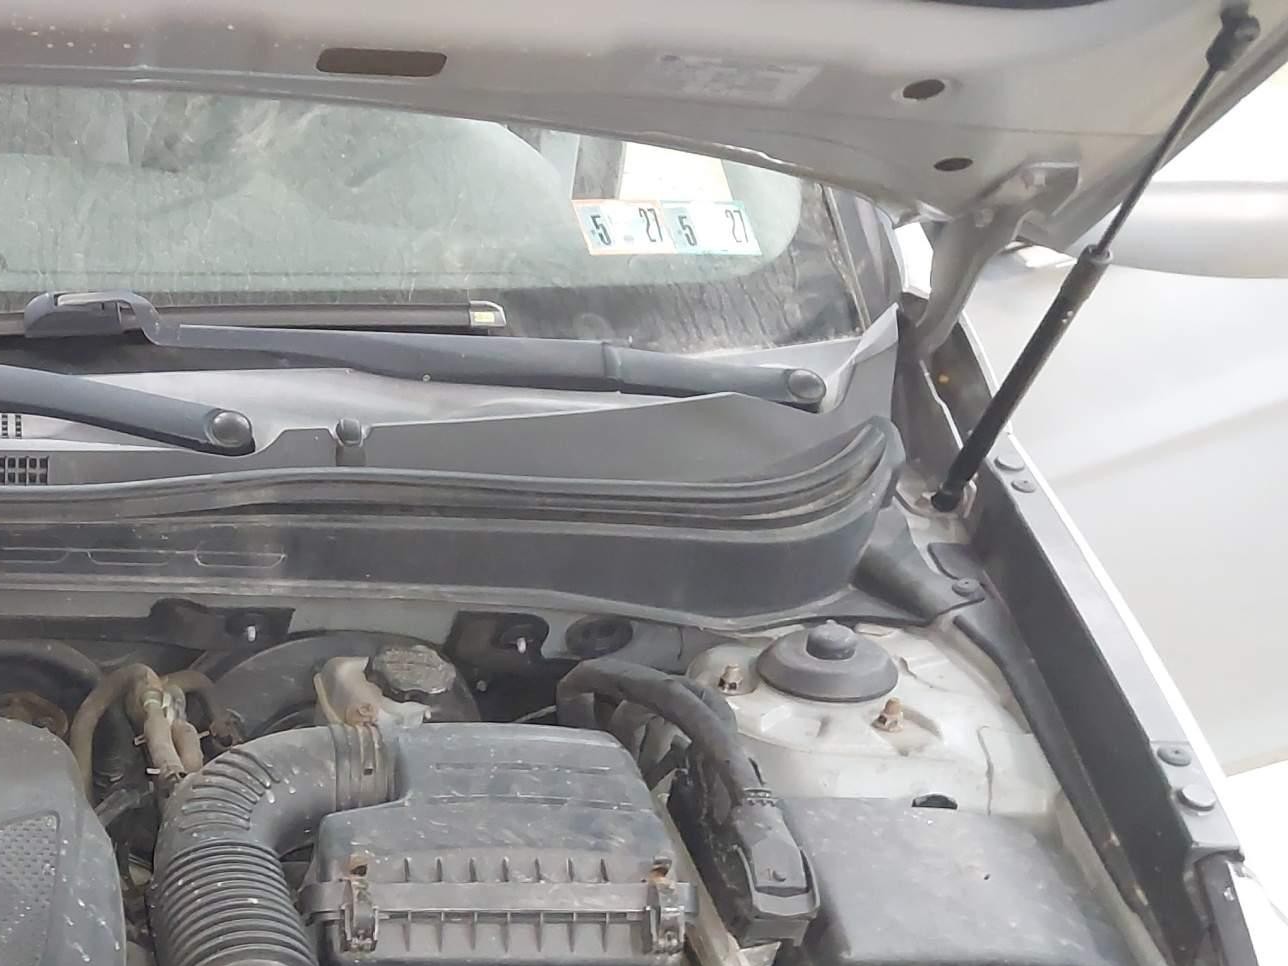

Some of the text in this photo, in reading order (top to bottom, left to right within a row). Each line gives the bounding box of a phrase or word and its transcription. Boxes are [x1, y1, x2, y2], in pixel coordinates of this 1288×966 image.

[590, 207, 663, 246] 5 27
[677, 209, 749, 247] 5 27
